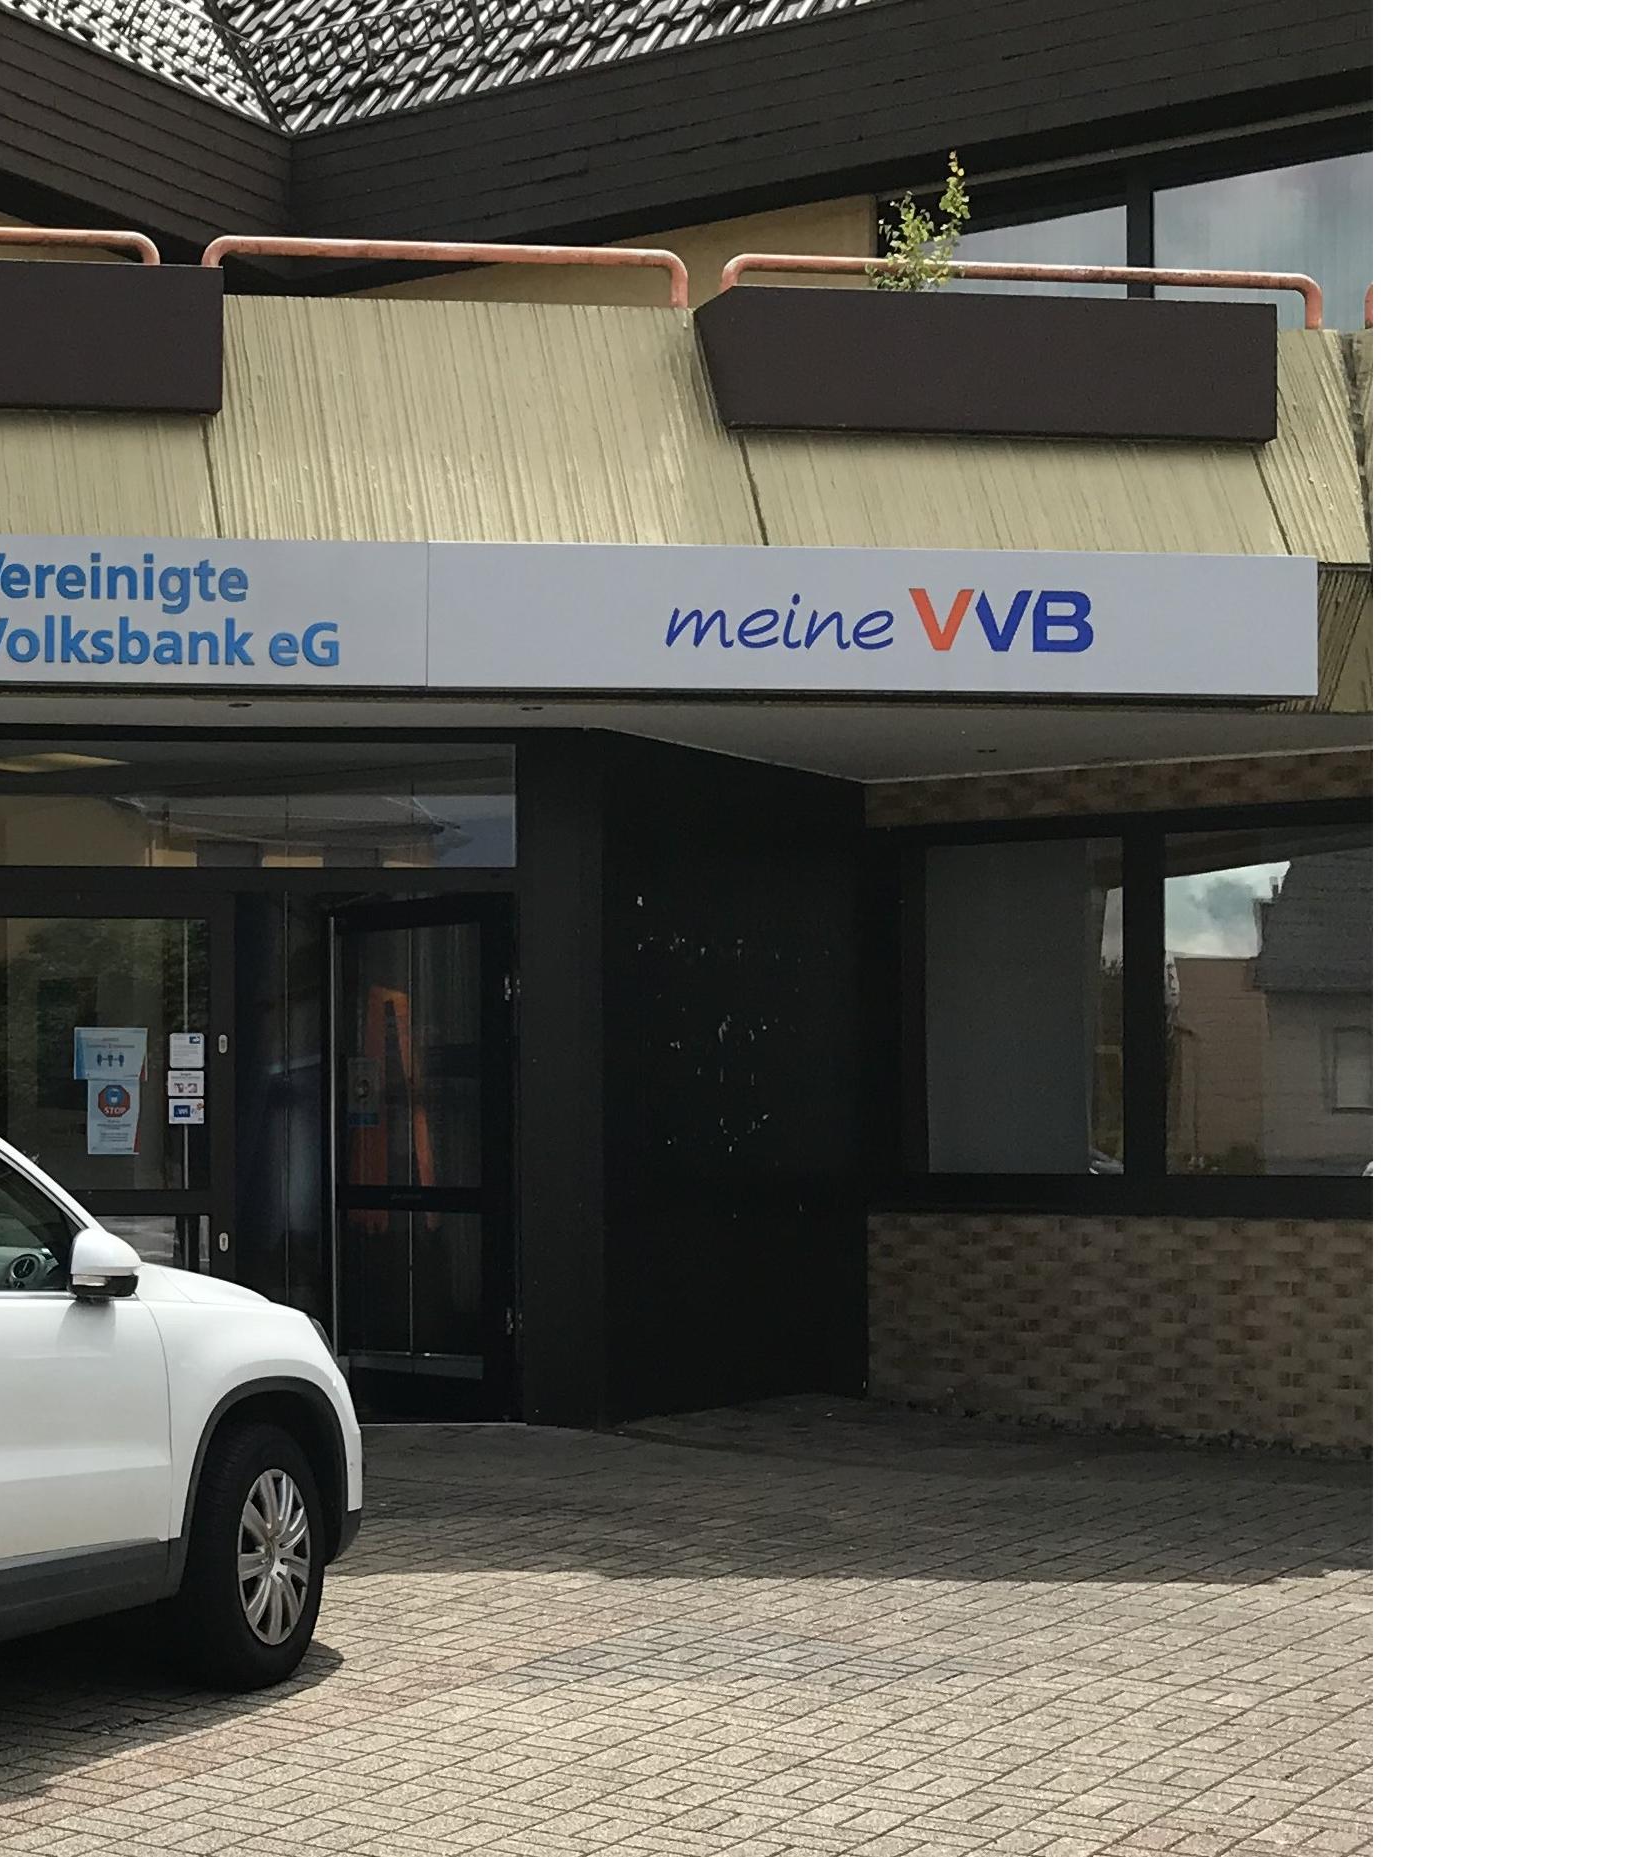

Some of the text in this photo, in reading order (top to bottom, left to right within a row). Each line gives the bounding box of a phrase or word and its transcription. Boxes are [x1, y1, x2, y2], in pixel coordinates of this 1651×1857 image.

[664, 587, 1093, 652] meine VVB
[269, 620, 340, 667] eG
[104, 1105, 128, 1115] STOP
